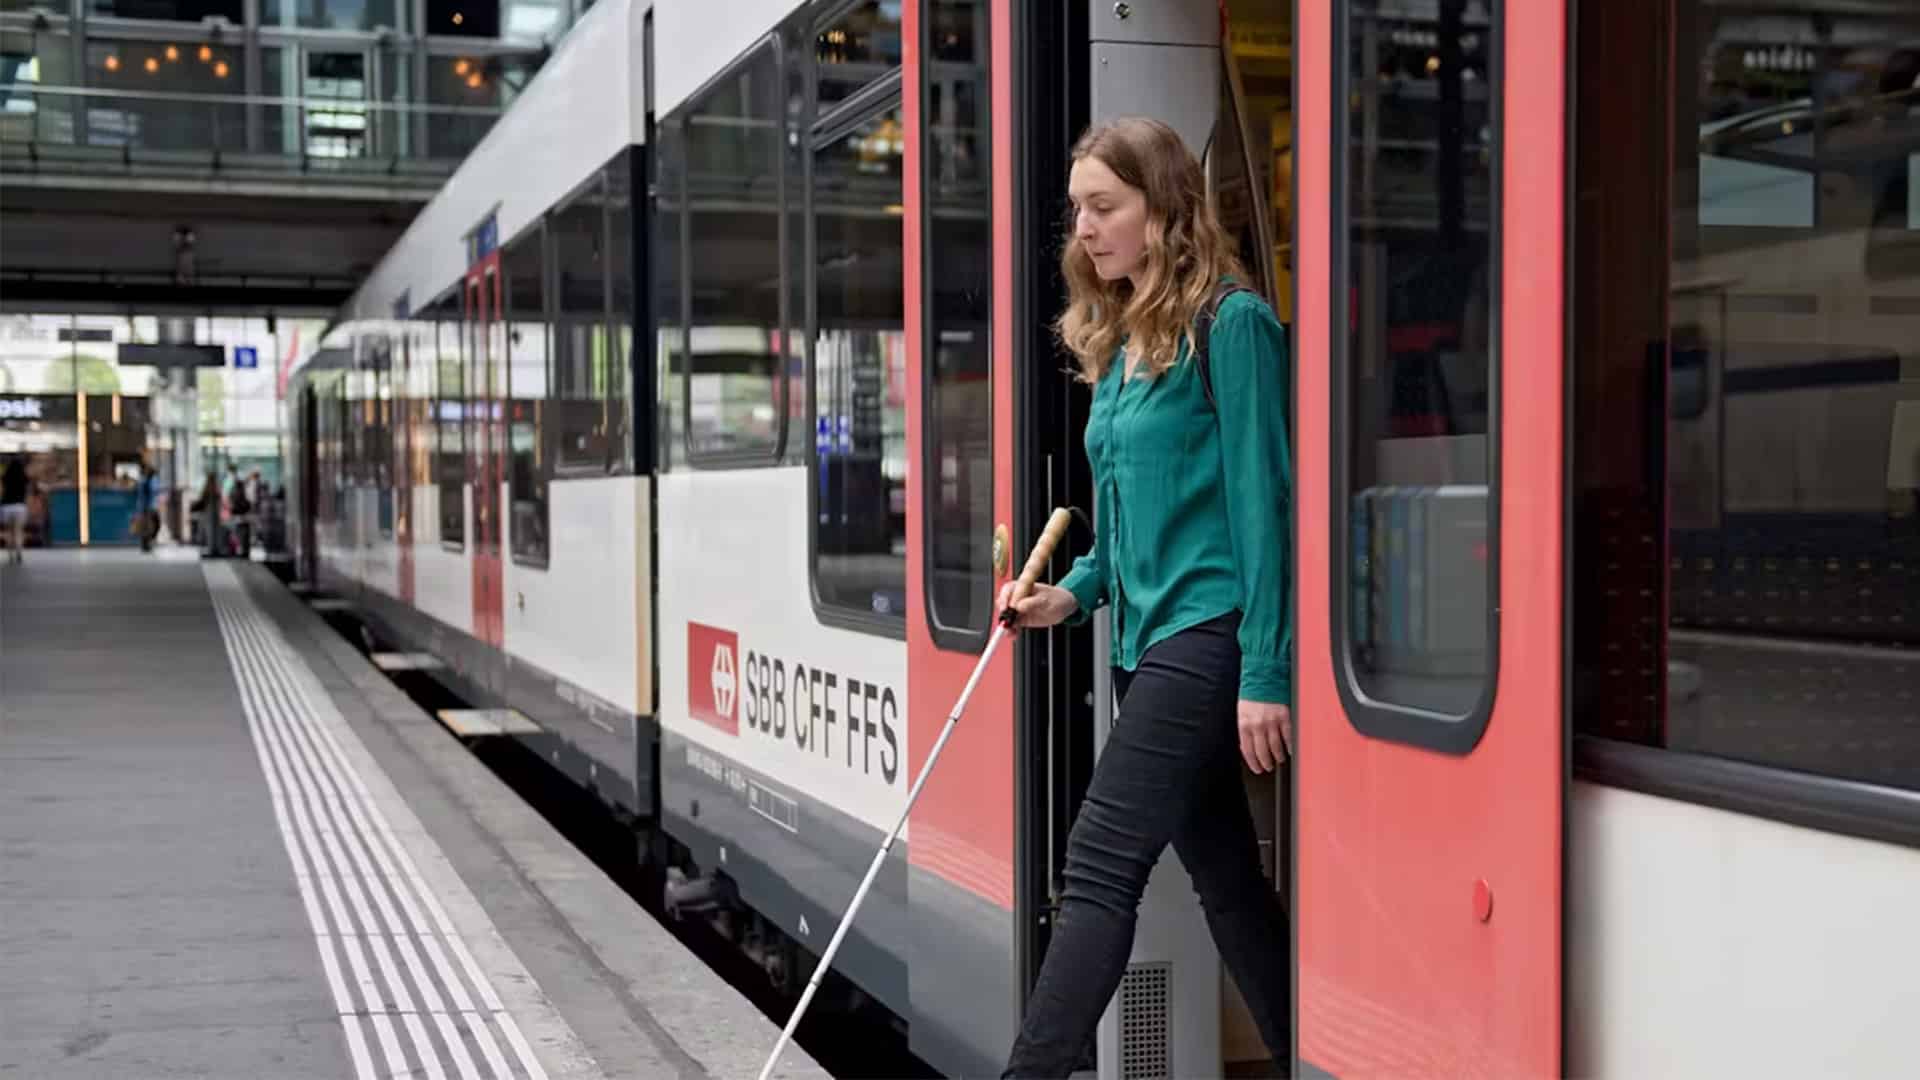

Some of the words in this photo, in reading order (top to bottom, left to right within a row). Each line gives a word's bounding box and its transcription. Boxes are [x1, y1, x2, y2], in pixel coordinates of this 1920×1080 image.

[746, 650, 786, 739] SBB
[793, 664, 837, 758] CFF
[847, 678, 898, 784] FFS
